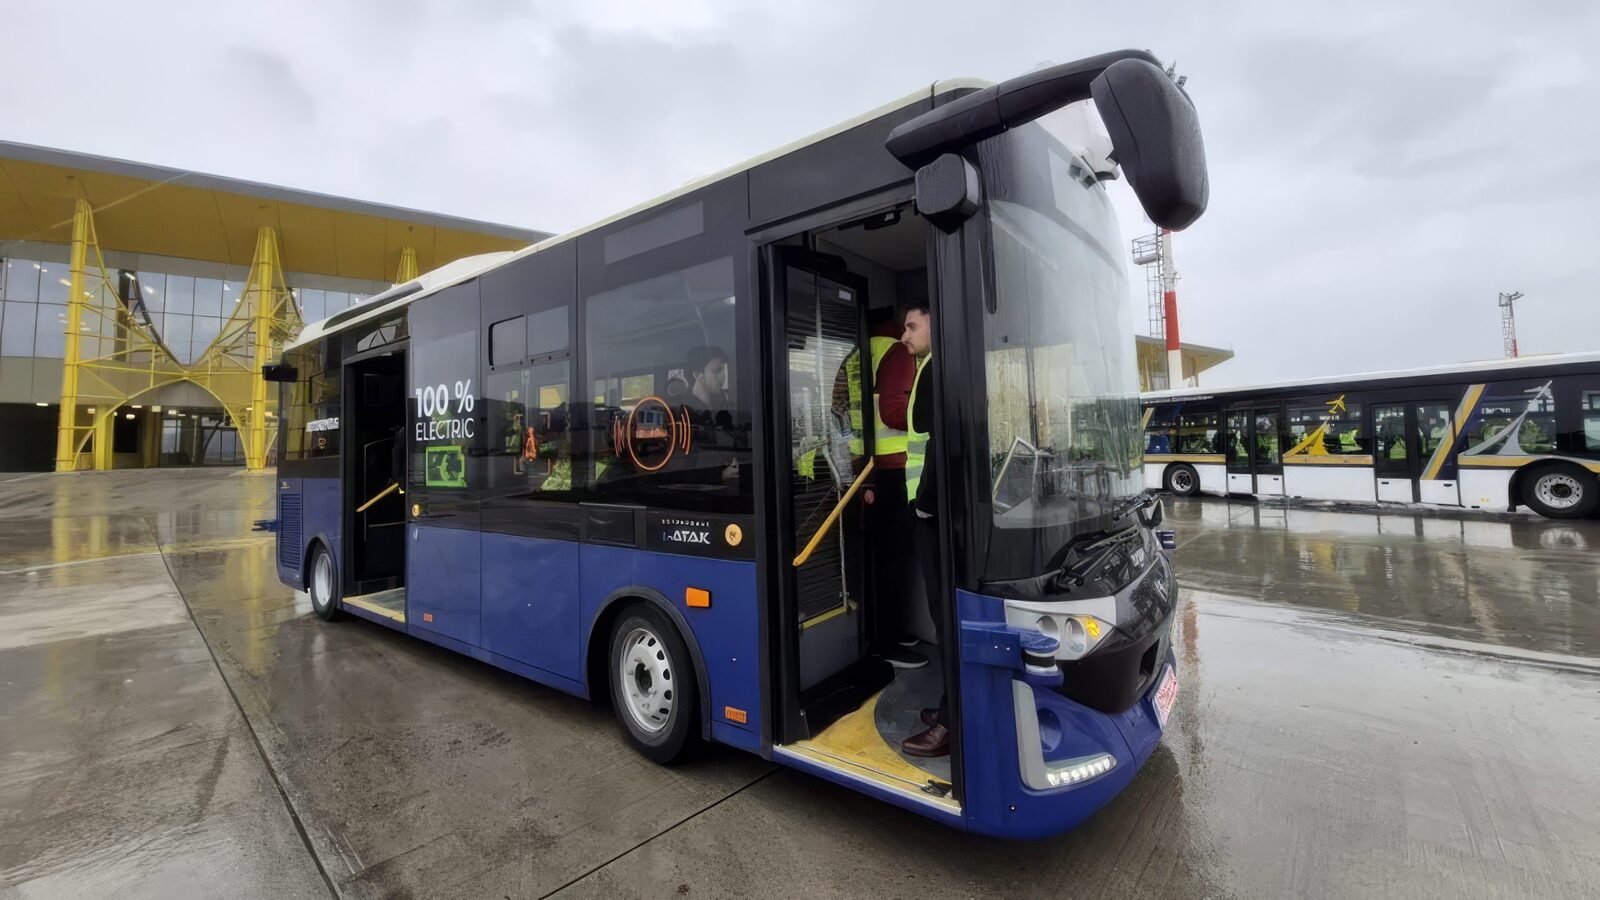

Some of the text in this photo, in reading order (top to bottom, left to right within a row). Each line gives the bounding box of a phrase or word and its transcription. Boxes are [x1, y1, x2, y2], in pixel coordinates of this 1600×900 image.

[416, 379, 474, 418] 100 %
[416, 418, 474, 441] ELECTRIC
